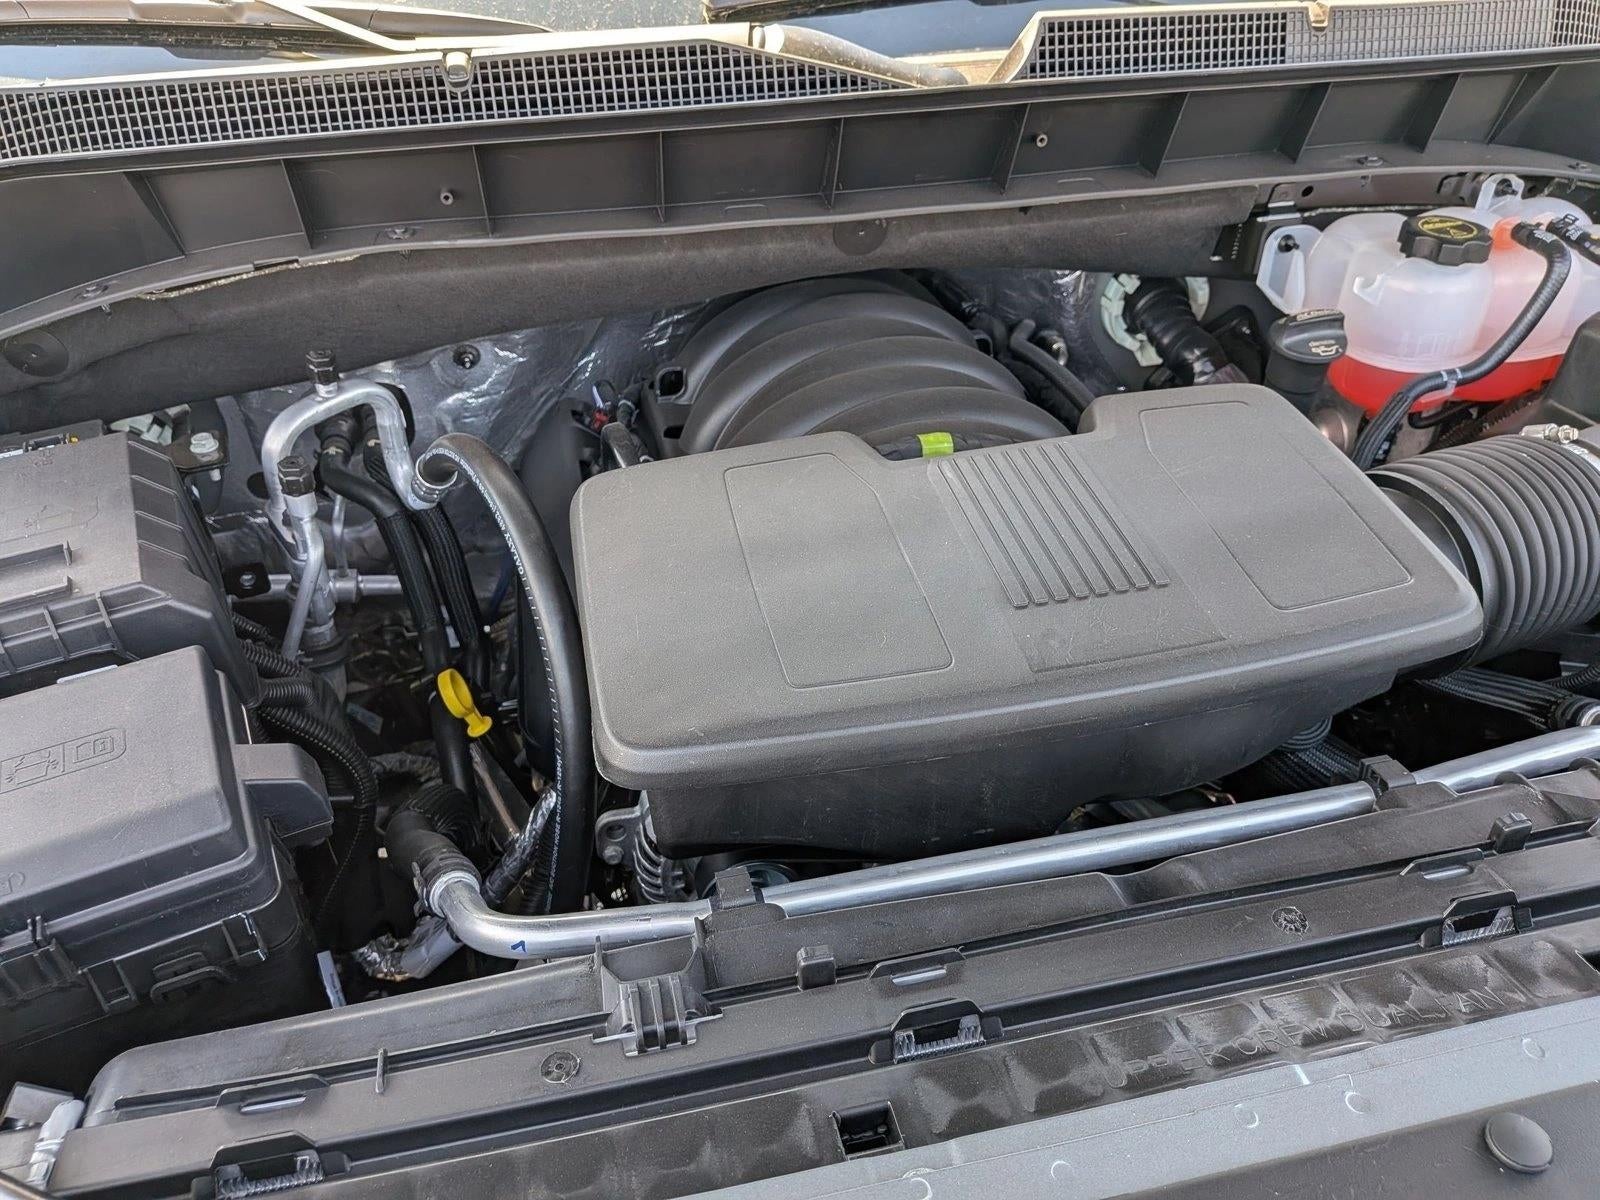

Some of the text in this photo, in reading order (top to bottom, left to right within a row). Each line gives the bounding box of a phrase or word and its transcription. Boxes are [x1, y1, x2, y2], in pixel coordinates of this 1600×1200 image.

[550, 846, 559, 878] SUCTION
[1103, 1041, 1231, 1089] UPPER
[1337, 1000, 1446, 1033] DUAL
[1435, 986, 1506, 1015] FAN
